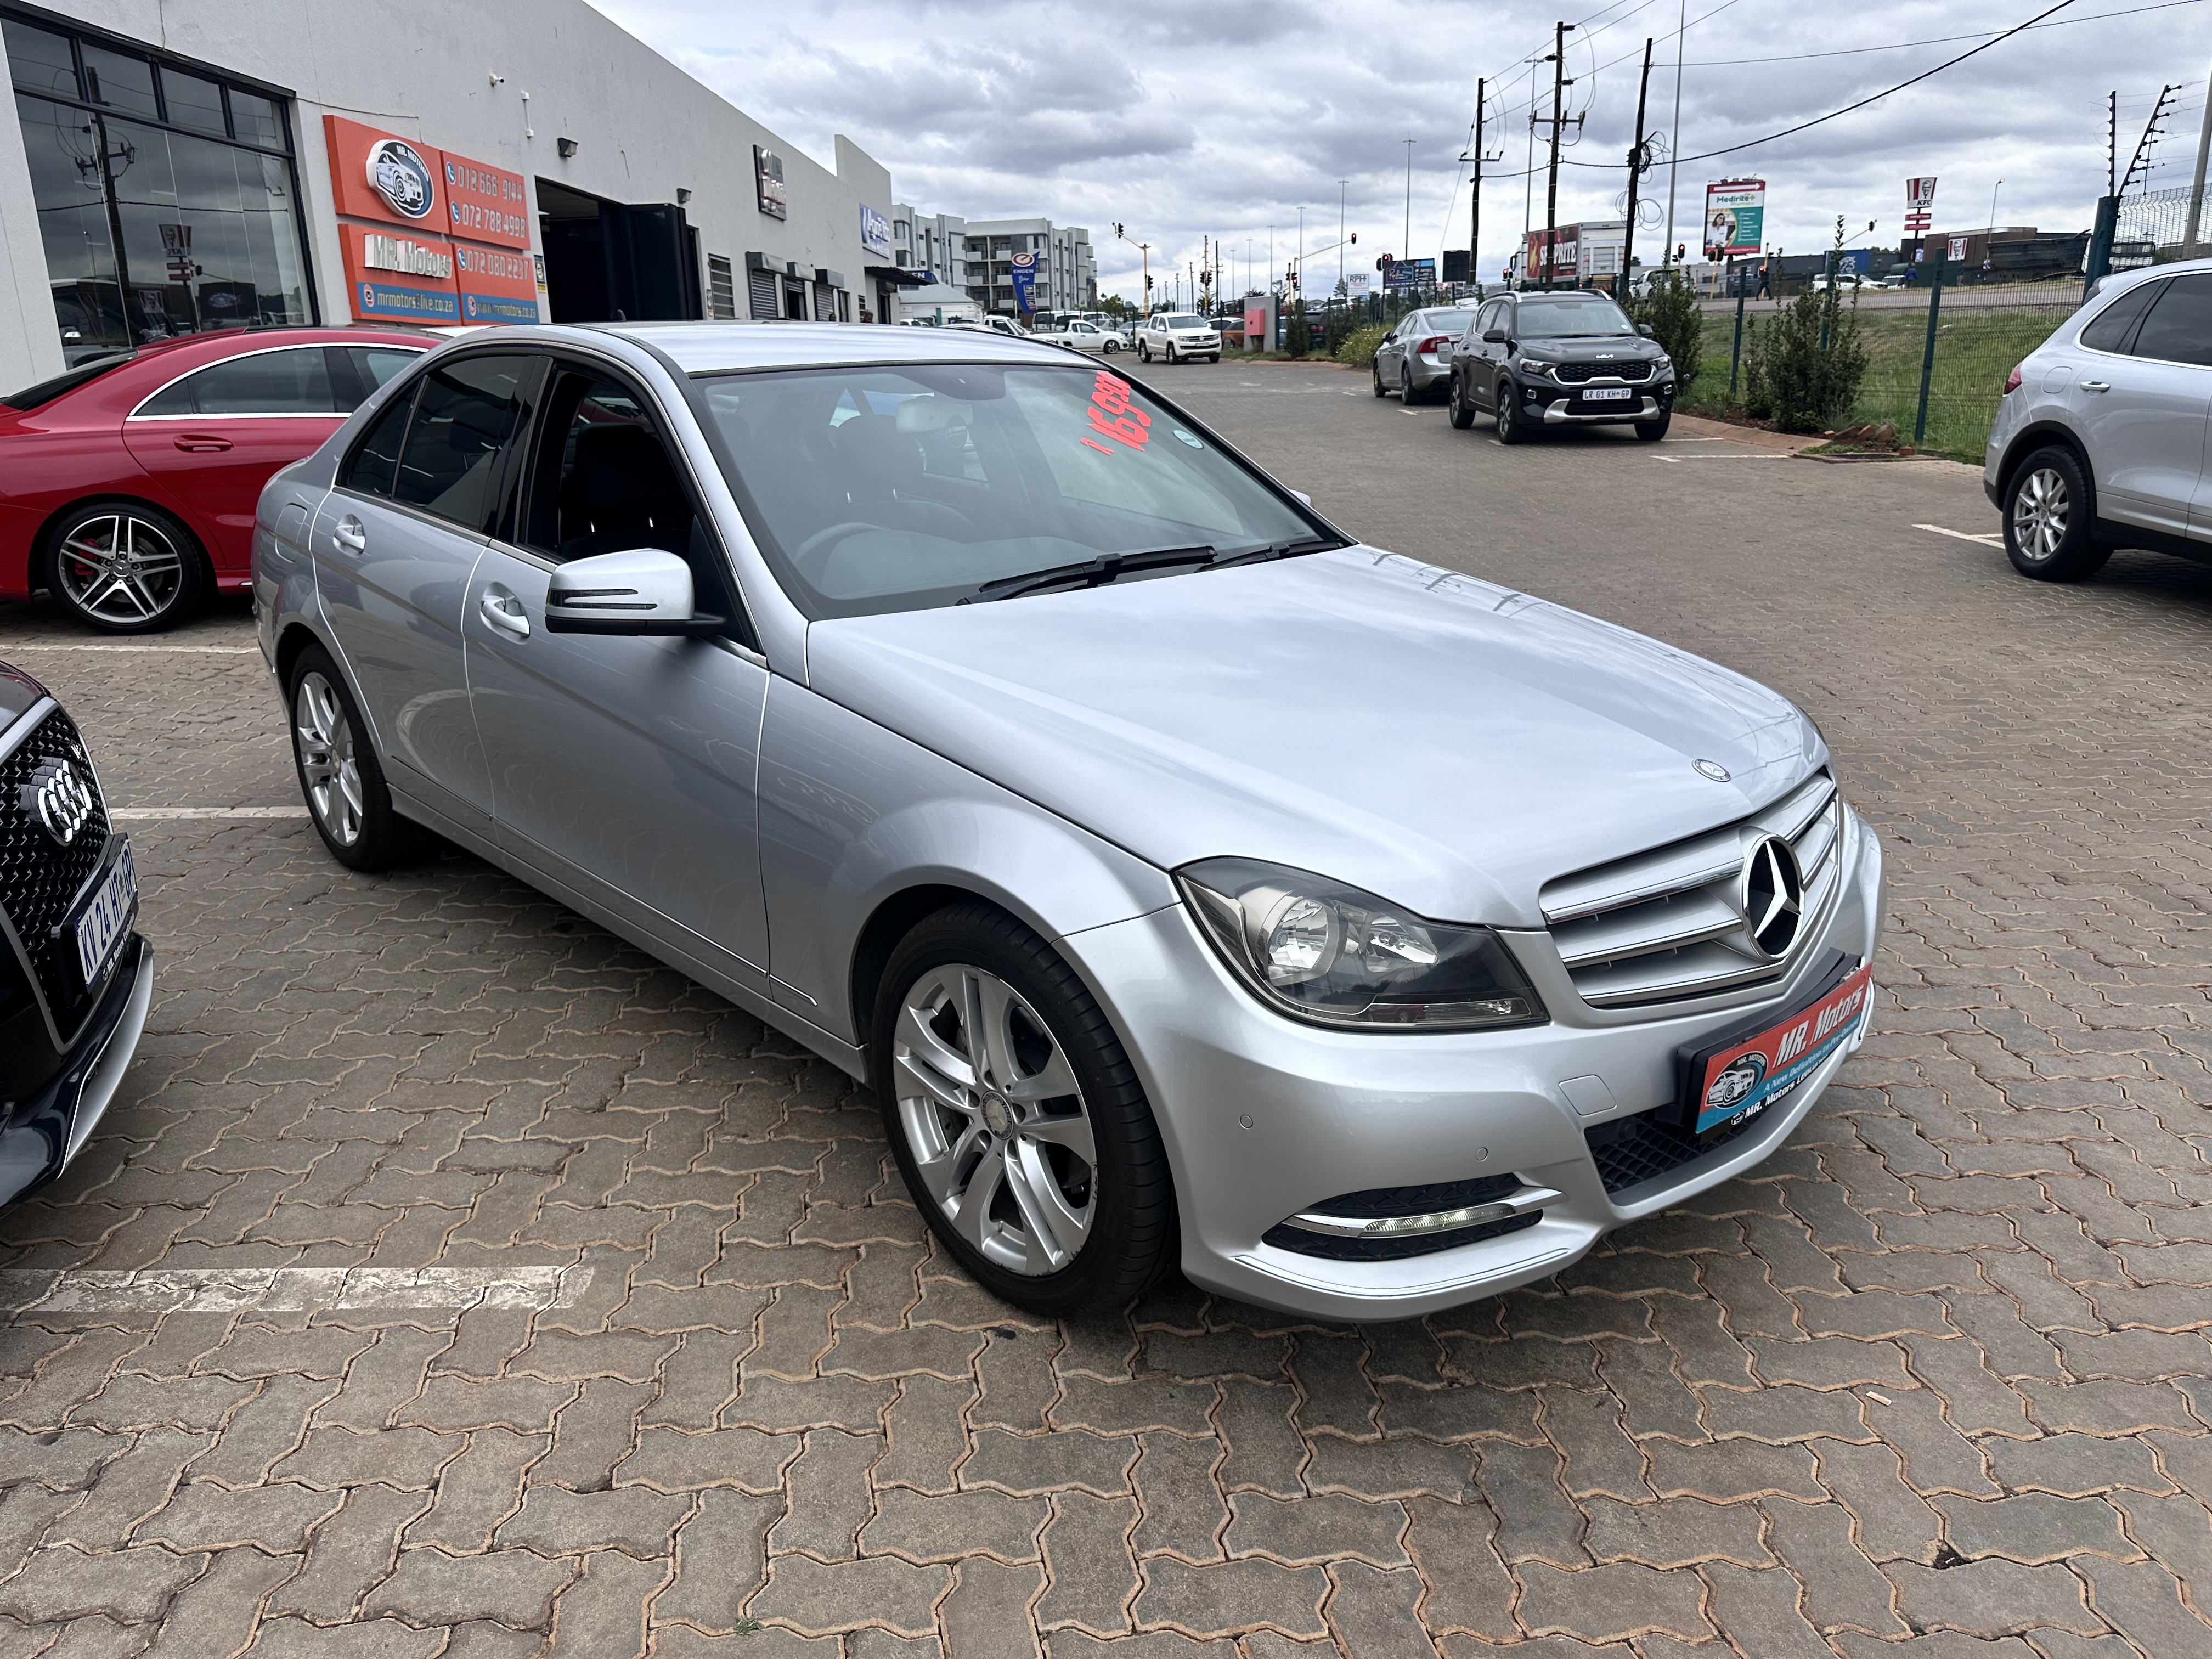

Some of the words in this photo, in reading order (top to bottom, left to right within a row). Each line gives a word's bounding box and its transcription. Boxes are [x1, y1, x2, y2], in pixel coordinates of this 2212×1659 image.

[396, 145, 408, 157] MR.
[458, 165, 478, 192] 012
[480, 171, 498, 197] 666
[503, 178, 523, 205] 9144
[462, 203, 482, 229] 072
[484, 208, 502, 233] 788
[504, 213, 526, 238] 4998
[365, 234, 400, 270] MR.
[397, 240, 452, 279] Motors
[467, 250, 487, 274] 072
[488, 253, 506, 276] 080
[508, 257, 529, 280] 2237
[1584, 391, 1593, 399] LR
[1607, 390, 1616, 398] KH
[1621, 390, 1629, 398] GP
[81, 914, 98, 978] KV
[96, 895, 111, 951] 24
[109, 871, 123, 927] HT
[122, 848, 133, 899] GP
[1772, 1020, 1809, 1069] MR.
[1809, 984, 1865, 1045] Motors
[1736, 1057, 1747, 1066] MR.
[1748, 1054, 1766, 1067] MOTORS
[1764, 1084, 1770, 1093] A
[1771, 1073, 1788, 1088] New
[1789, 1049, 1822, 1077] Definition
[1745, 1101, 1763, 1119] MR.
[1765, 1080, 1795, 1106] Motors
